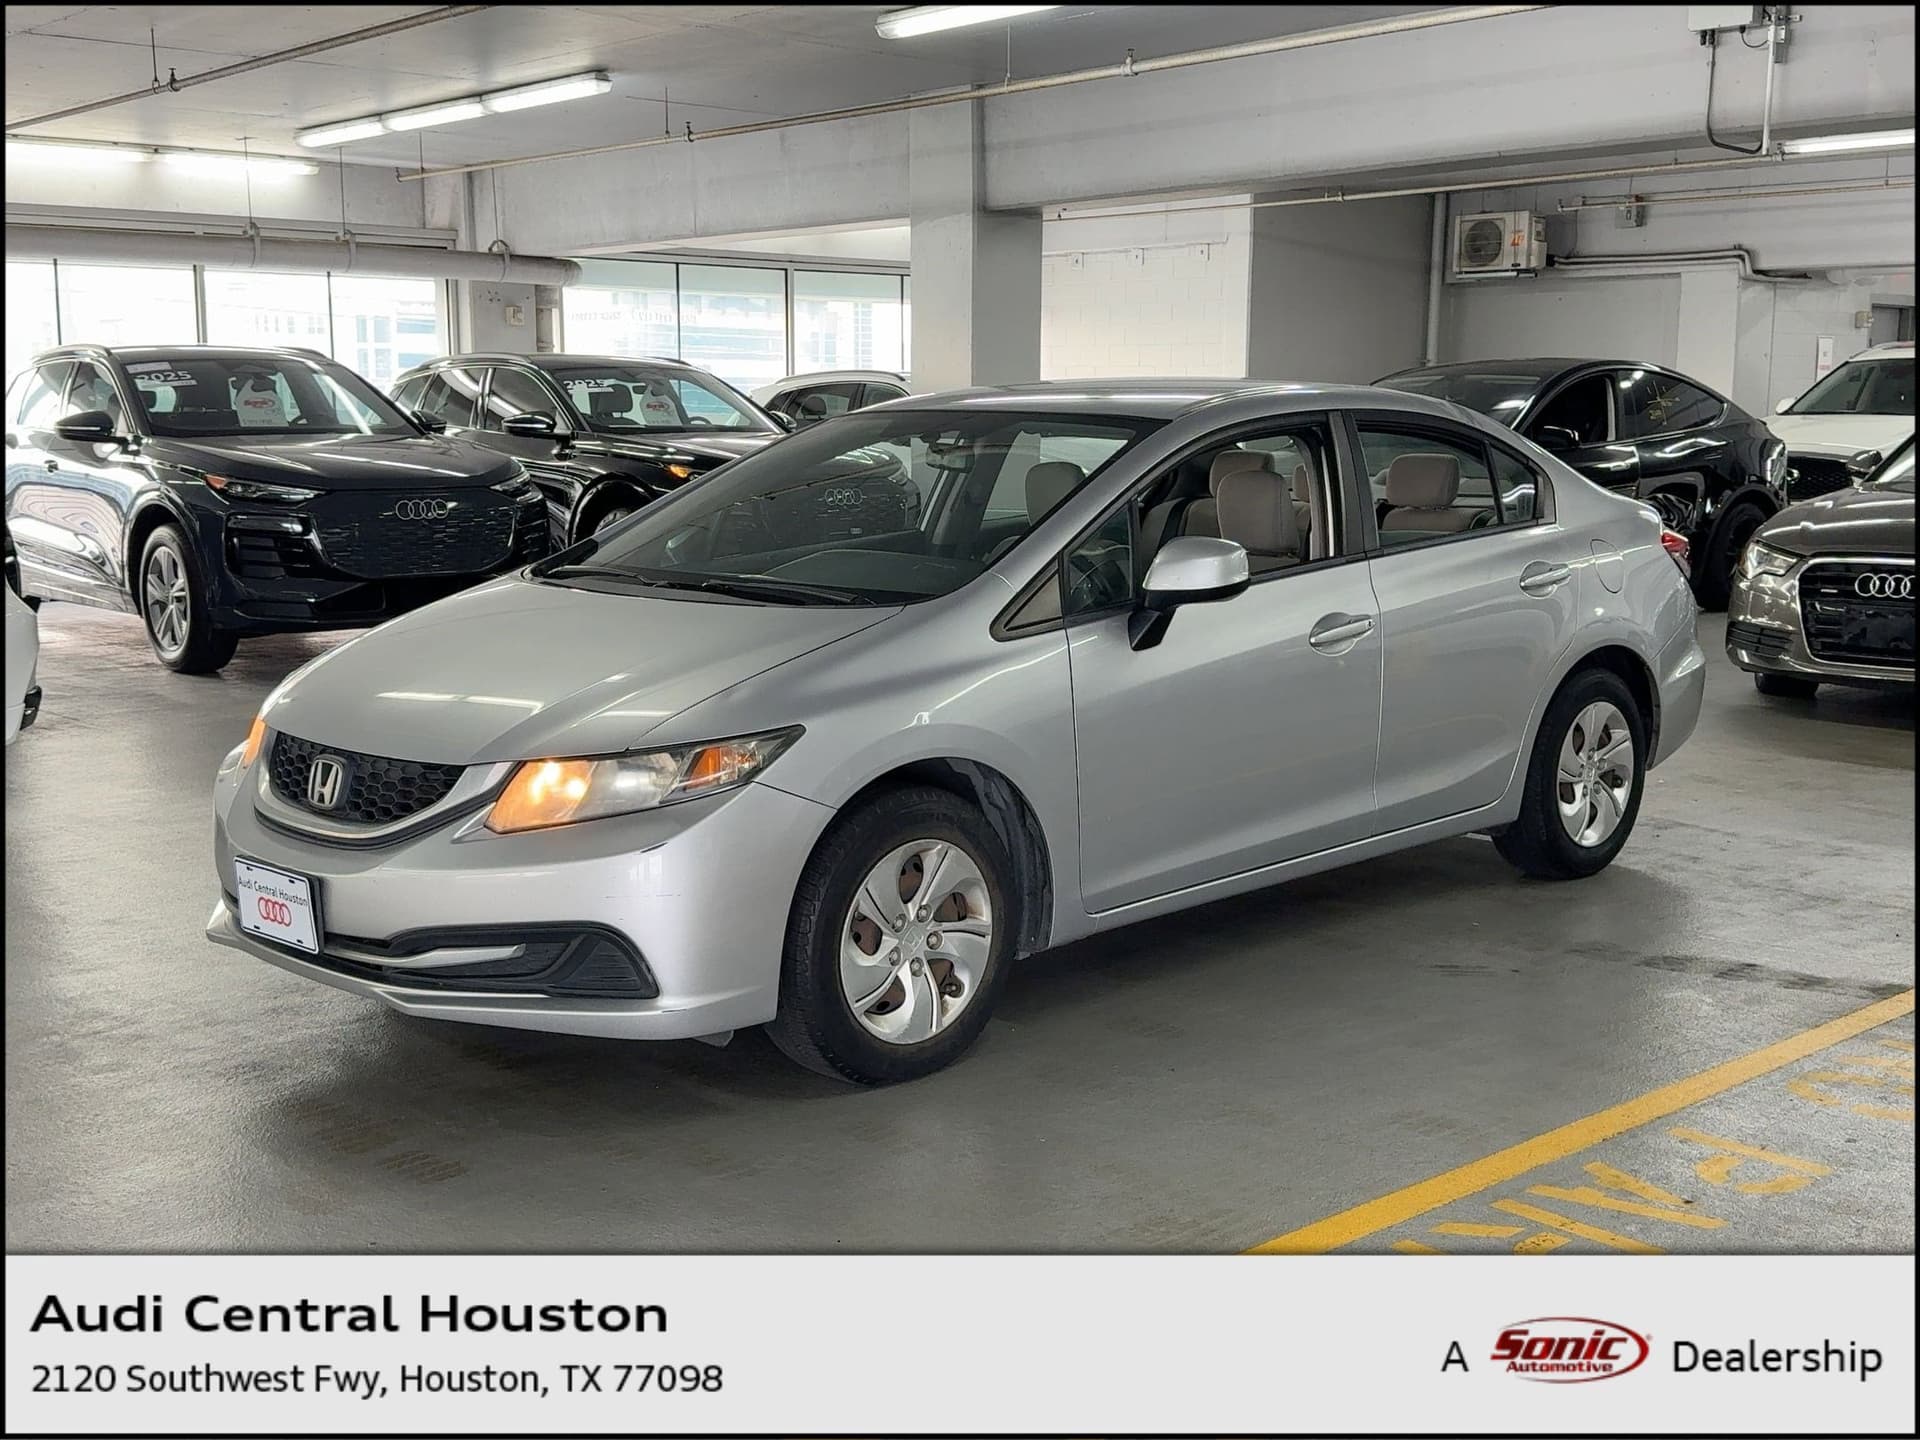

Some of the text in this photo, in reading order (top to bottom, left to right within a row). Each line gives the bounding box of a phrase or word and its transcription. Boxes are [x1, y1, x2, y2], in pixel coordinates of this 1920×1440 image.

[135, 370, 192, 382] 2025
[239, 876, 309, 906] Audi Central Houston
[1391, 1127, 1833, 1255] PAR
